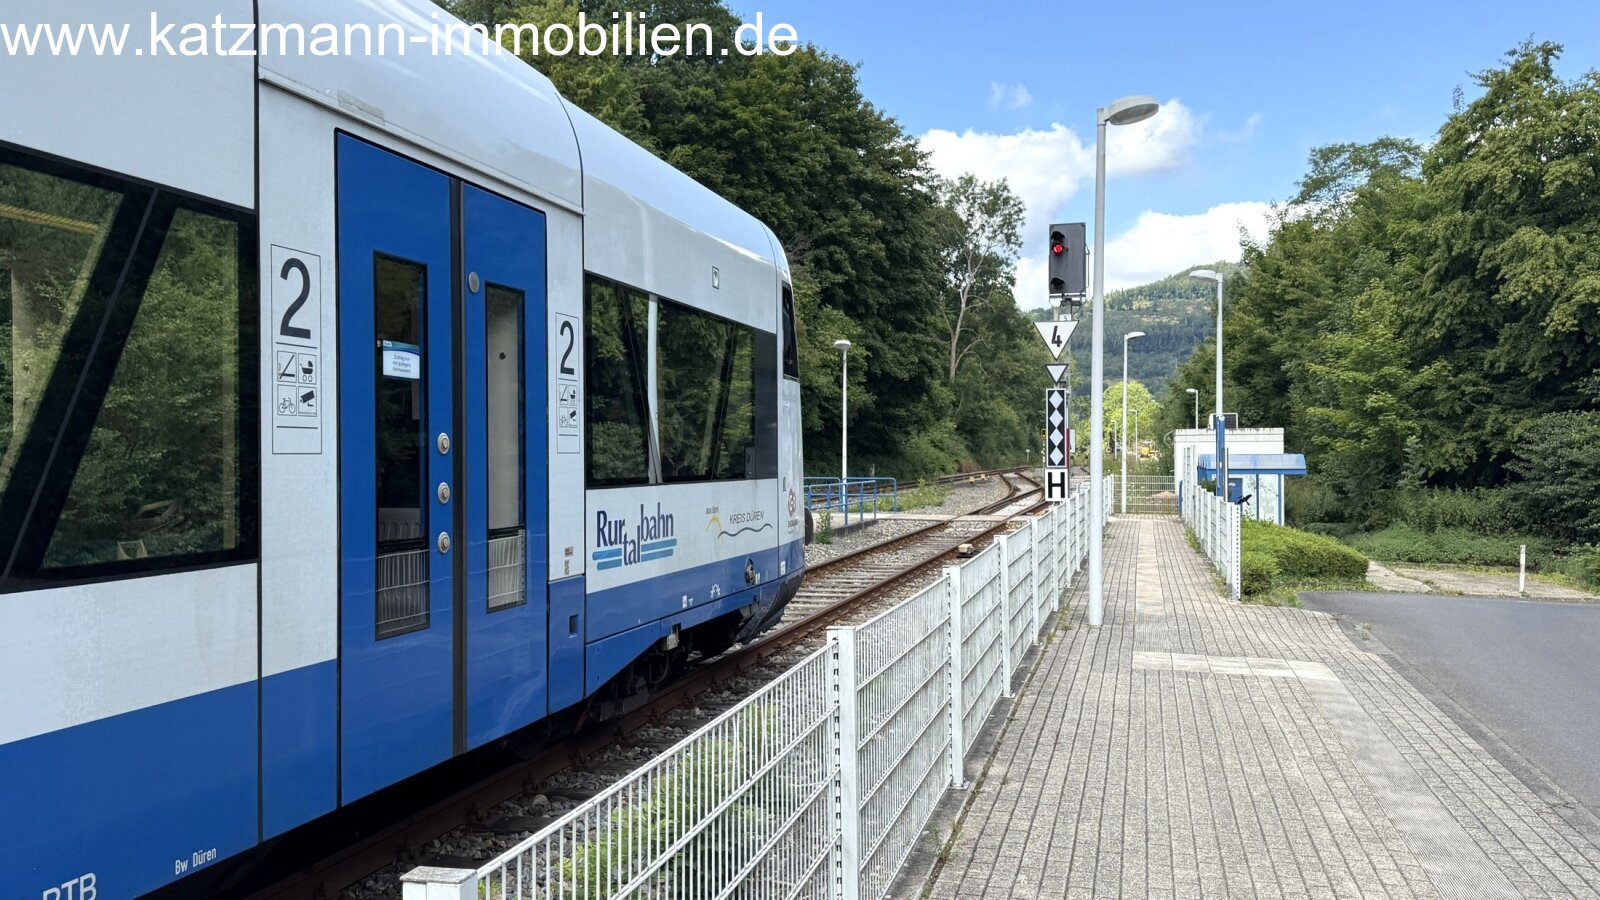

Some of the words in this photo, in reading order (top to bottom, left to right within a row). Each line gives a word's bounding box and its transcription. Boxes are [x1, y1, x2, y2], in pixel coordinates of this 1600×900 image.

[280, 257, 311, 340] 2
[560, 321, 574, 375] 2
[1051, 325, 1063, 347] 4
[1048, 472, 1065, 498] H
[729, 513, 745, 524] KREIS
[746, 510, 764, 522] DÜREN
[175, 859, 188, 875] Bw
[192, 848, 217, 868] Düren
